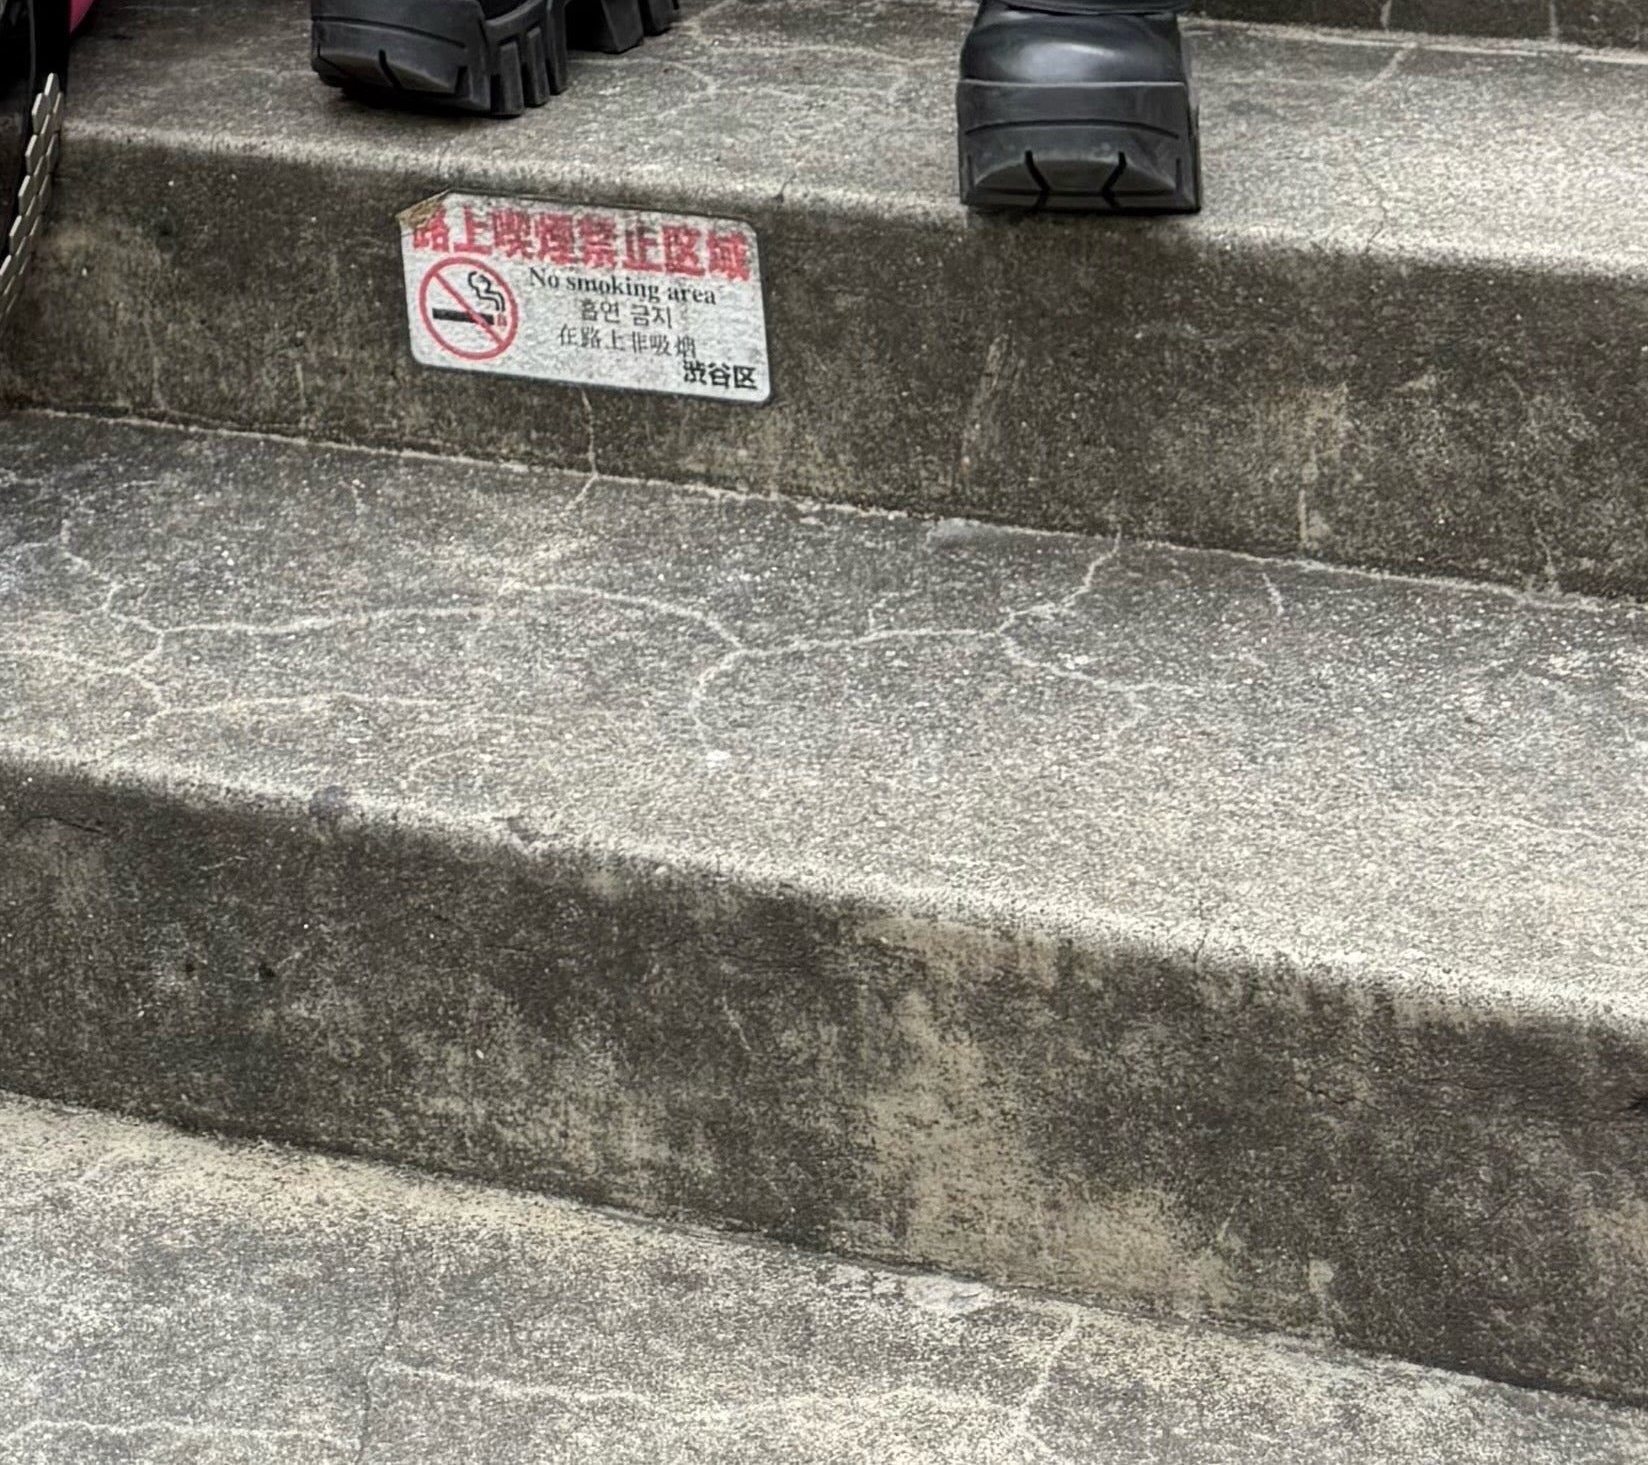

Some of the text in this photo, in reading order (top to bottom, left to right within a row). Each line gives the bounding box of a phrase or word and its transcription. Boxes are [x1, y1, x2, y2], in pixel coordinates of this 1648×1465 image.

[529, 267, 717, 305] No smoking area
[580, 300, 673, 329] 흡연 금지
[682, 359, 758, 391] 渋谷区
